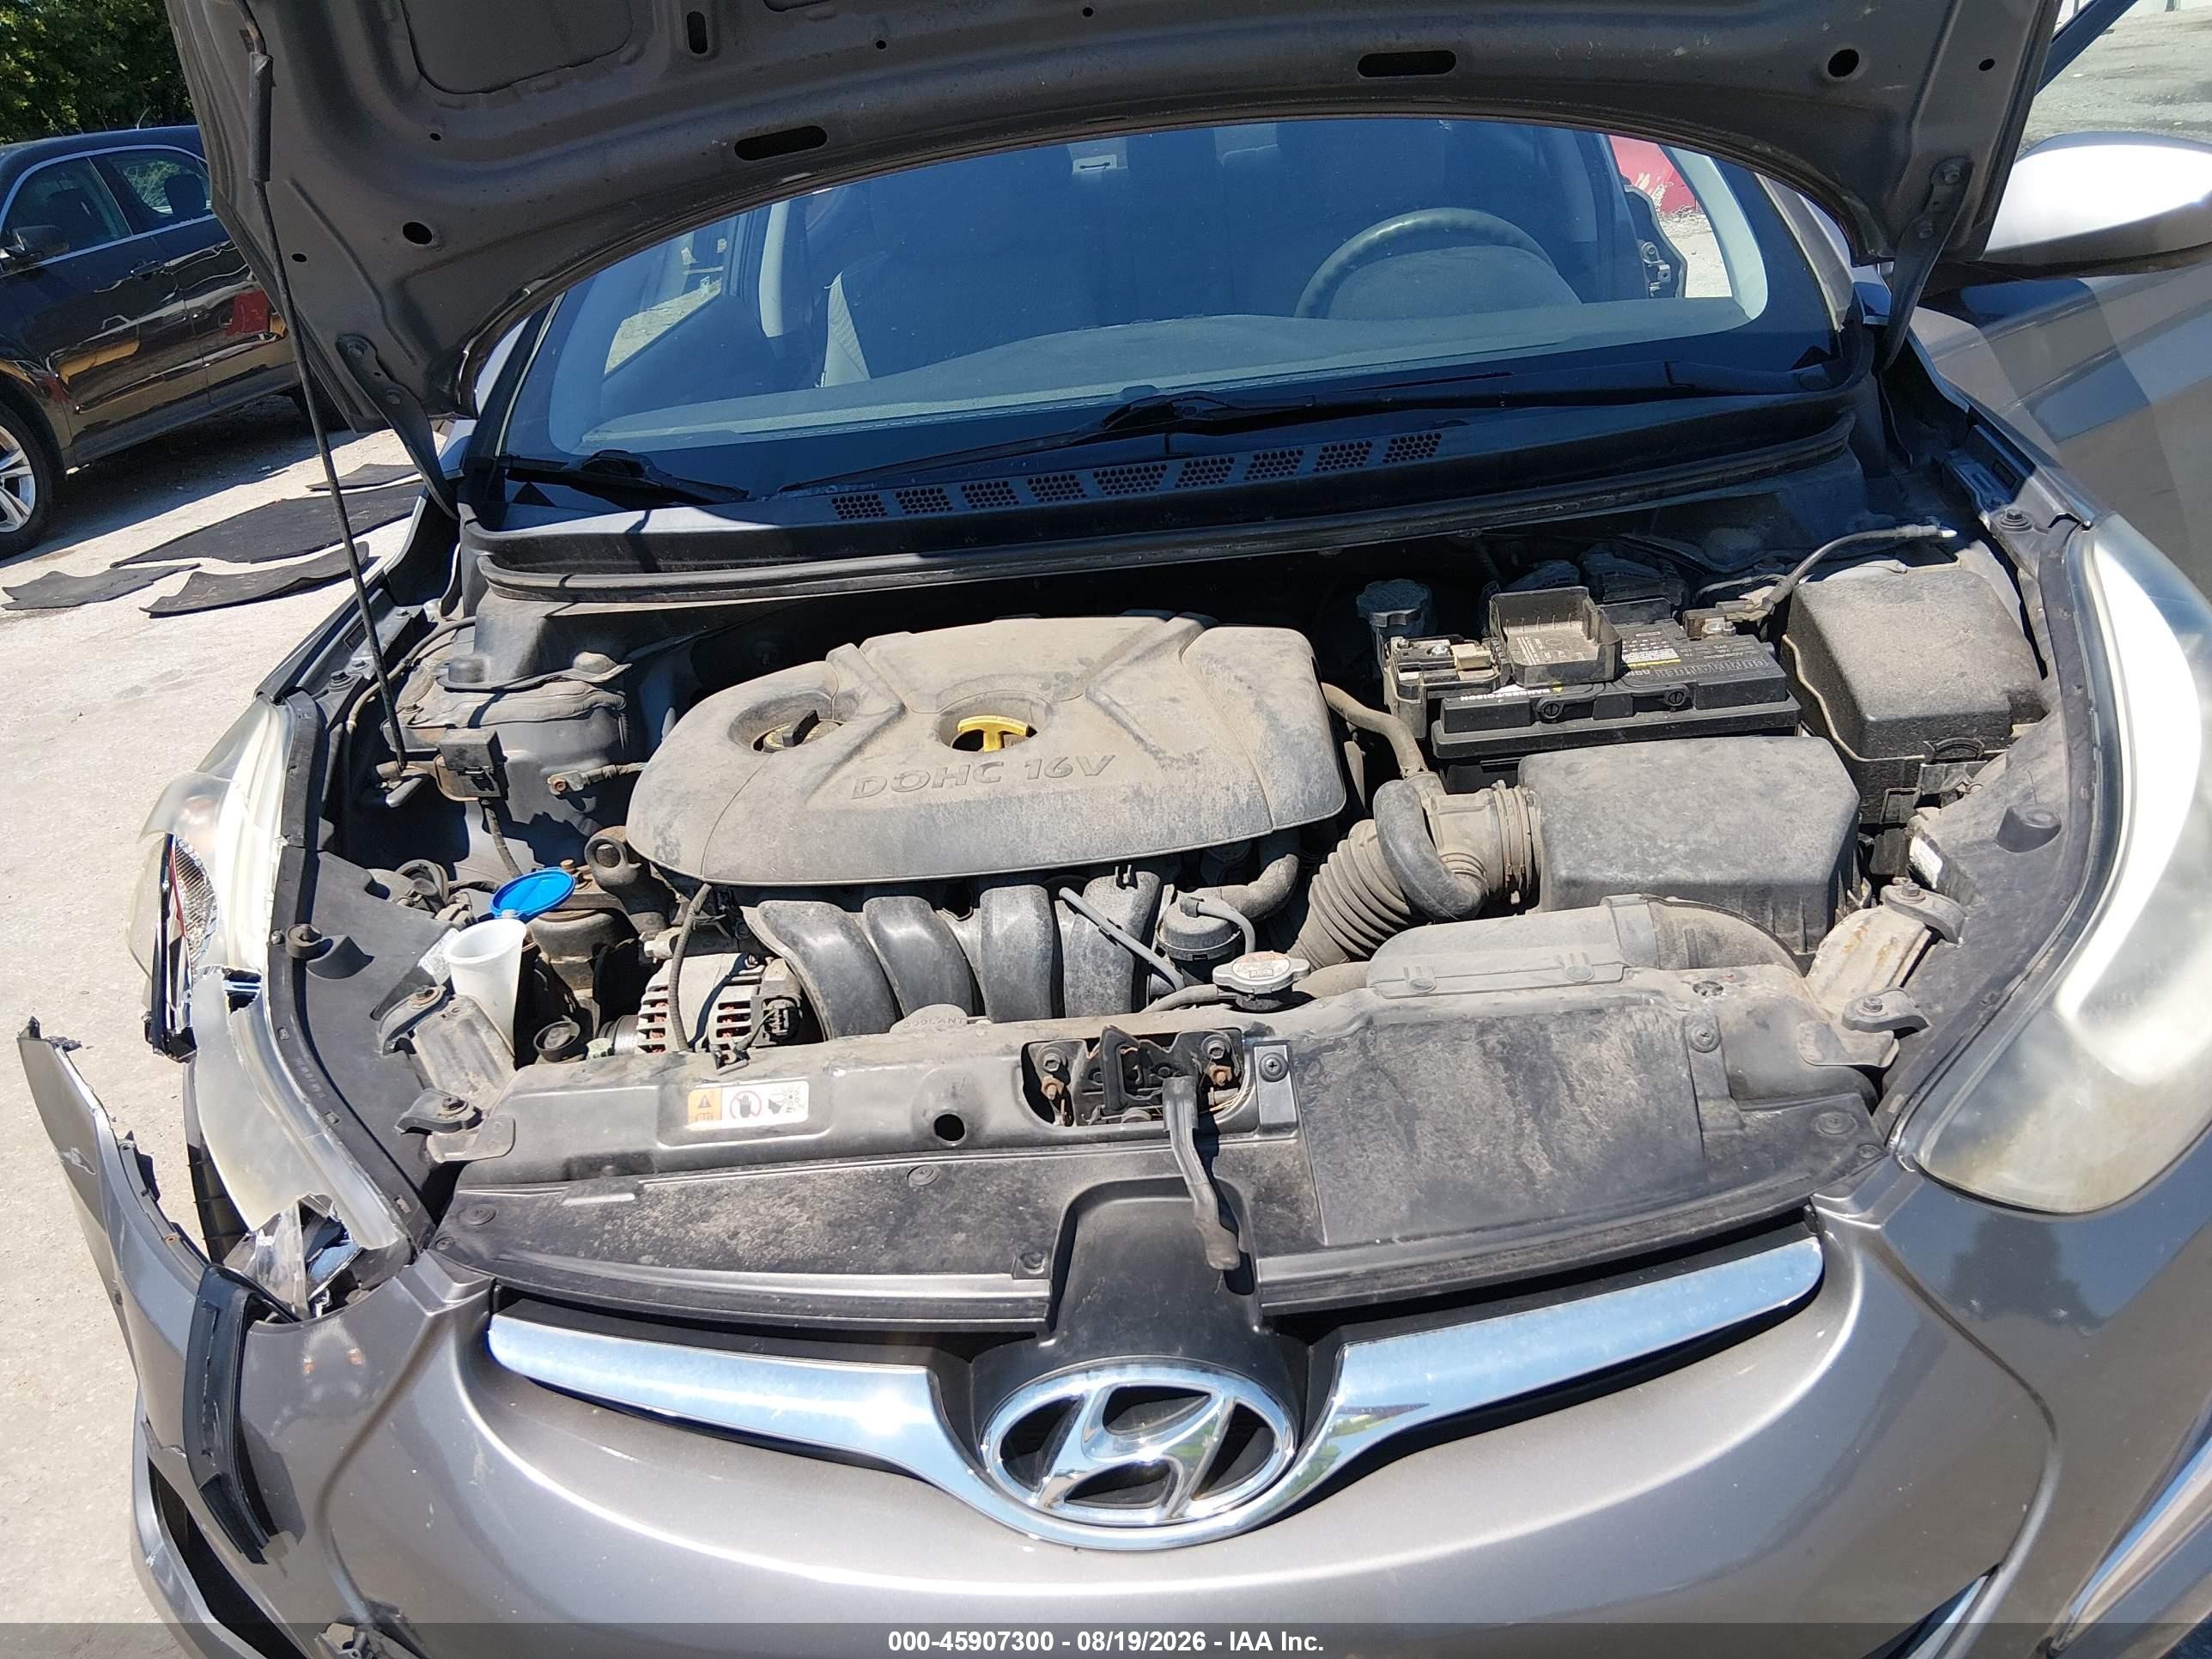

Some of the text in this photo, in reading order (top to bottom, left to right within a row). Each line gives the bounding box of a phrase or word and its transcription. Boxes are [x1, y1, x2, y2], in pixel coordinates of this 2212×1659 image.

[1655, 658, 1769, 678] COMMANDER
[851, 755, 1115, 799] DOHC 16V
[902, 1016, 966, 1030] COOLANT
